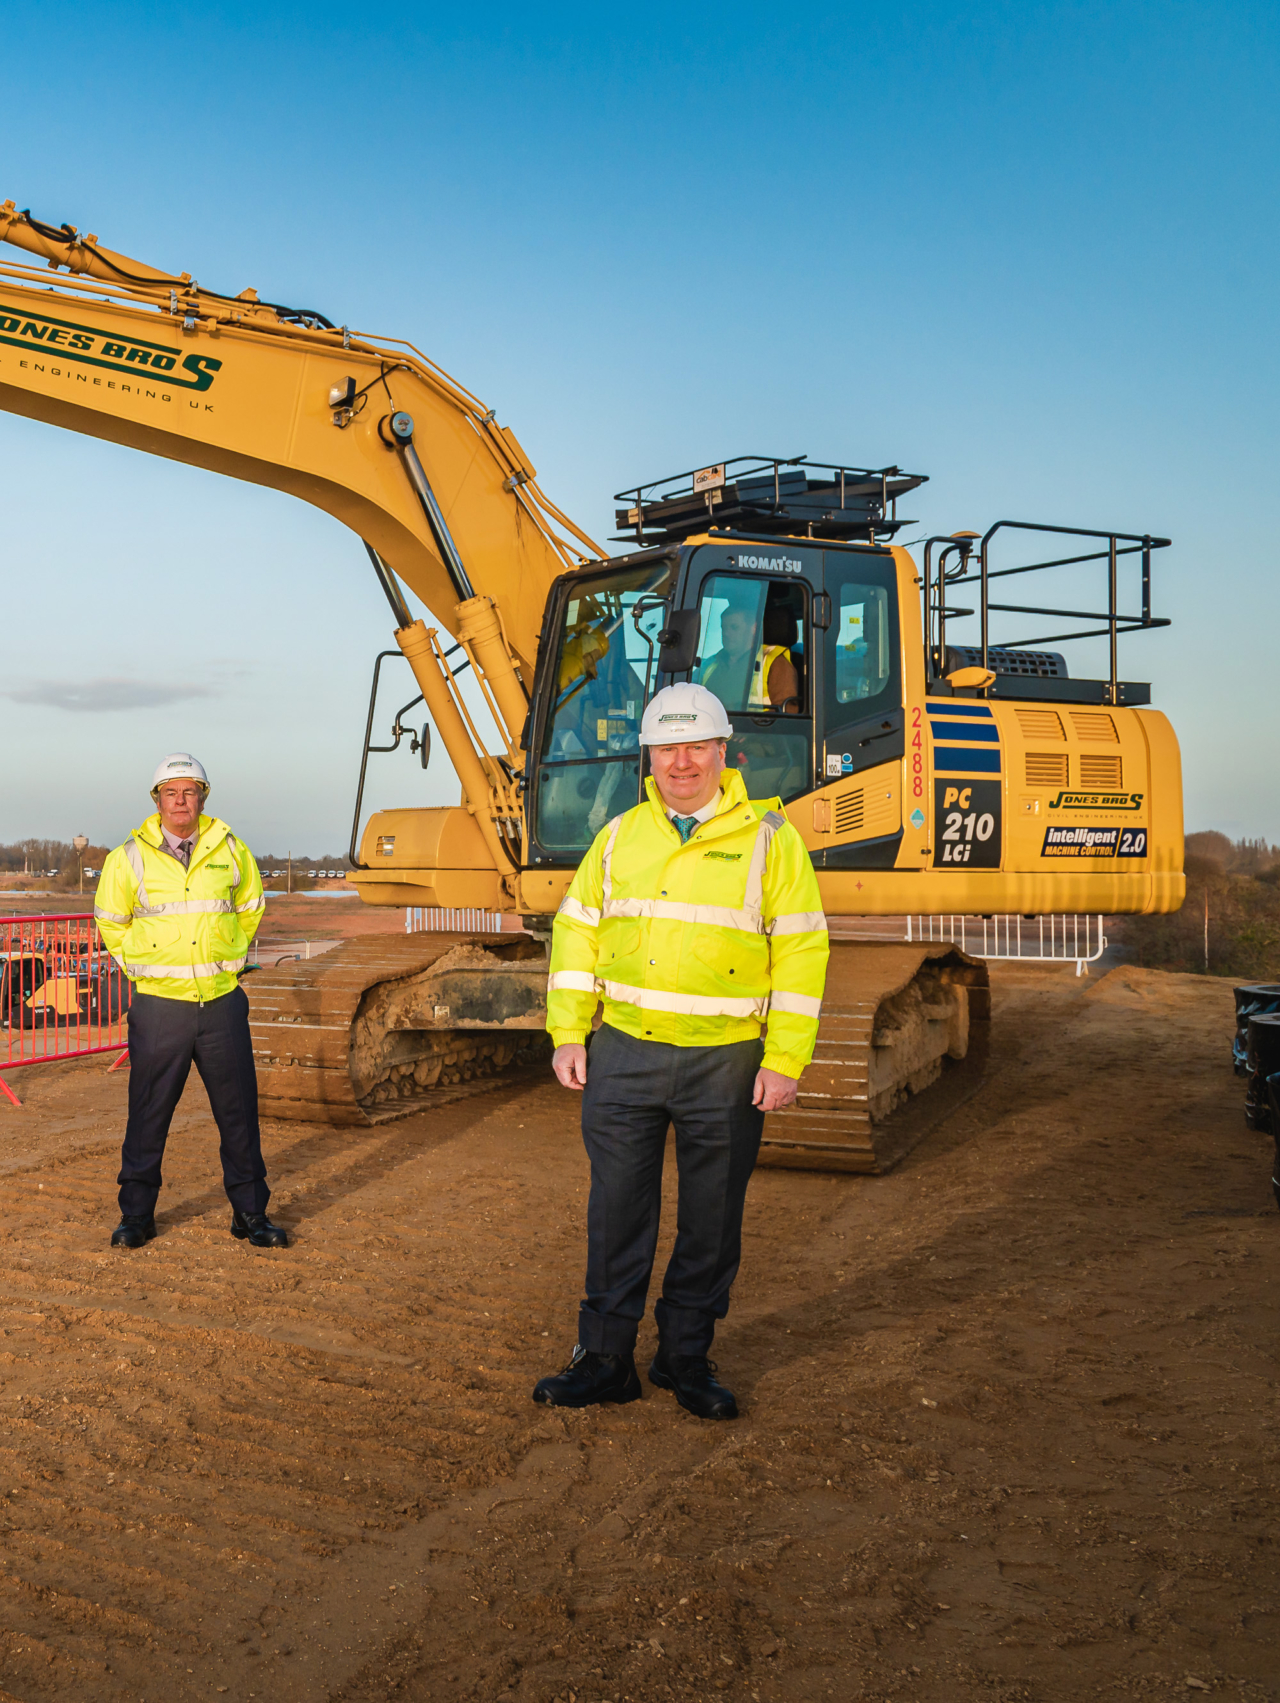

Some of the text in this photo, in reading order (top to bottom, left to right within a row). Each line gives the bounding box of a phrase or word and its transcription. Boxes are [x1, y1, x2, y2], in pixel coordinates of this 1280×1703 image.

[100, 341, 223, 392] BROS
[19, 360, 172, 402] ENGINEERING
[189, 400, 214, 412] UK
[738, 555, 802, 573] KOMATSU
[911, 706, 923, 798] 2488
[943, 787, 972, 809] PC
[1048, 792, 1144, 811] JONES BROS
[942, 812, 995, 841] 210
[1047, 828, 1117, 847] intelligent
[1120, 833, 1145, 853] 2.0
[942, 844, 971, 862] LCi
[1044, 846, 1113, 856] MACHINE CONTROL
